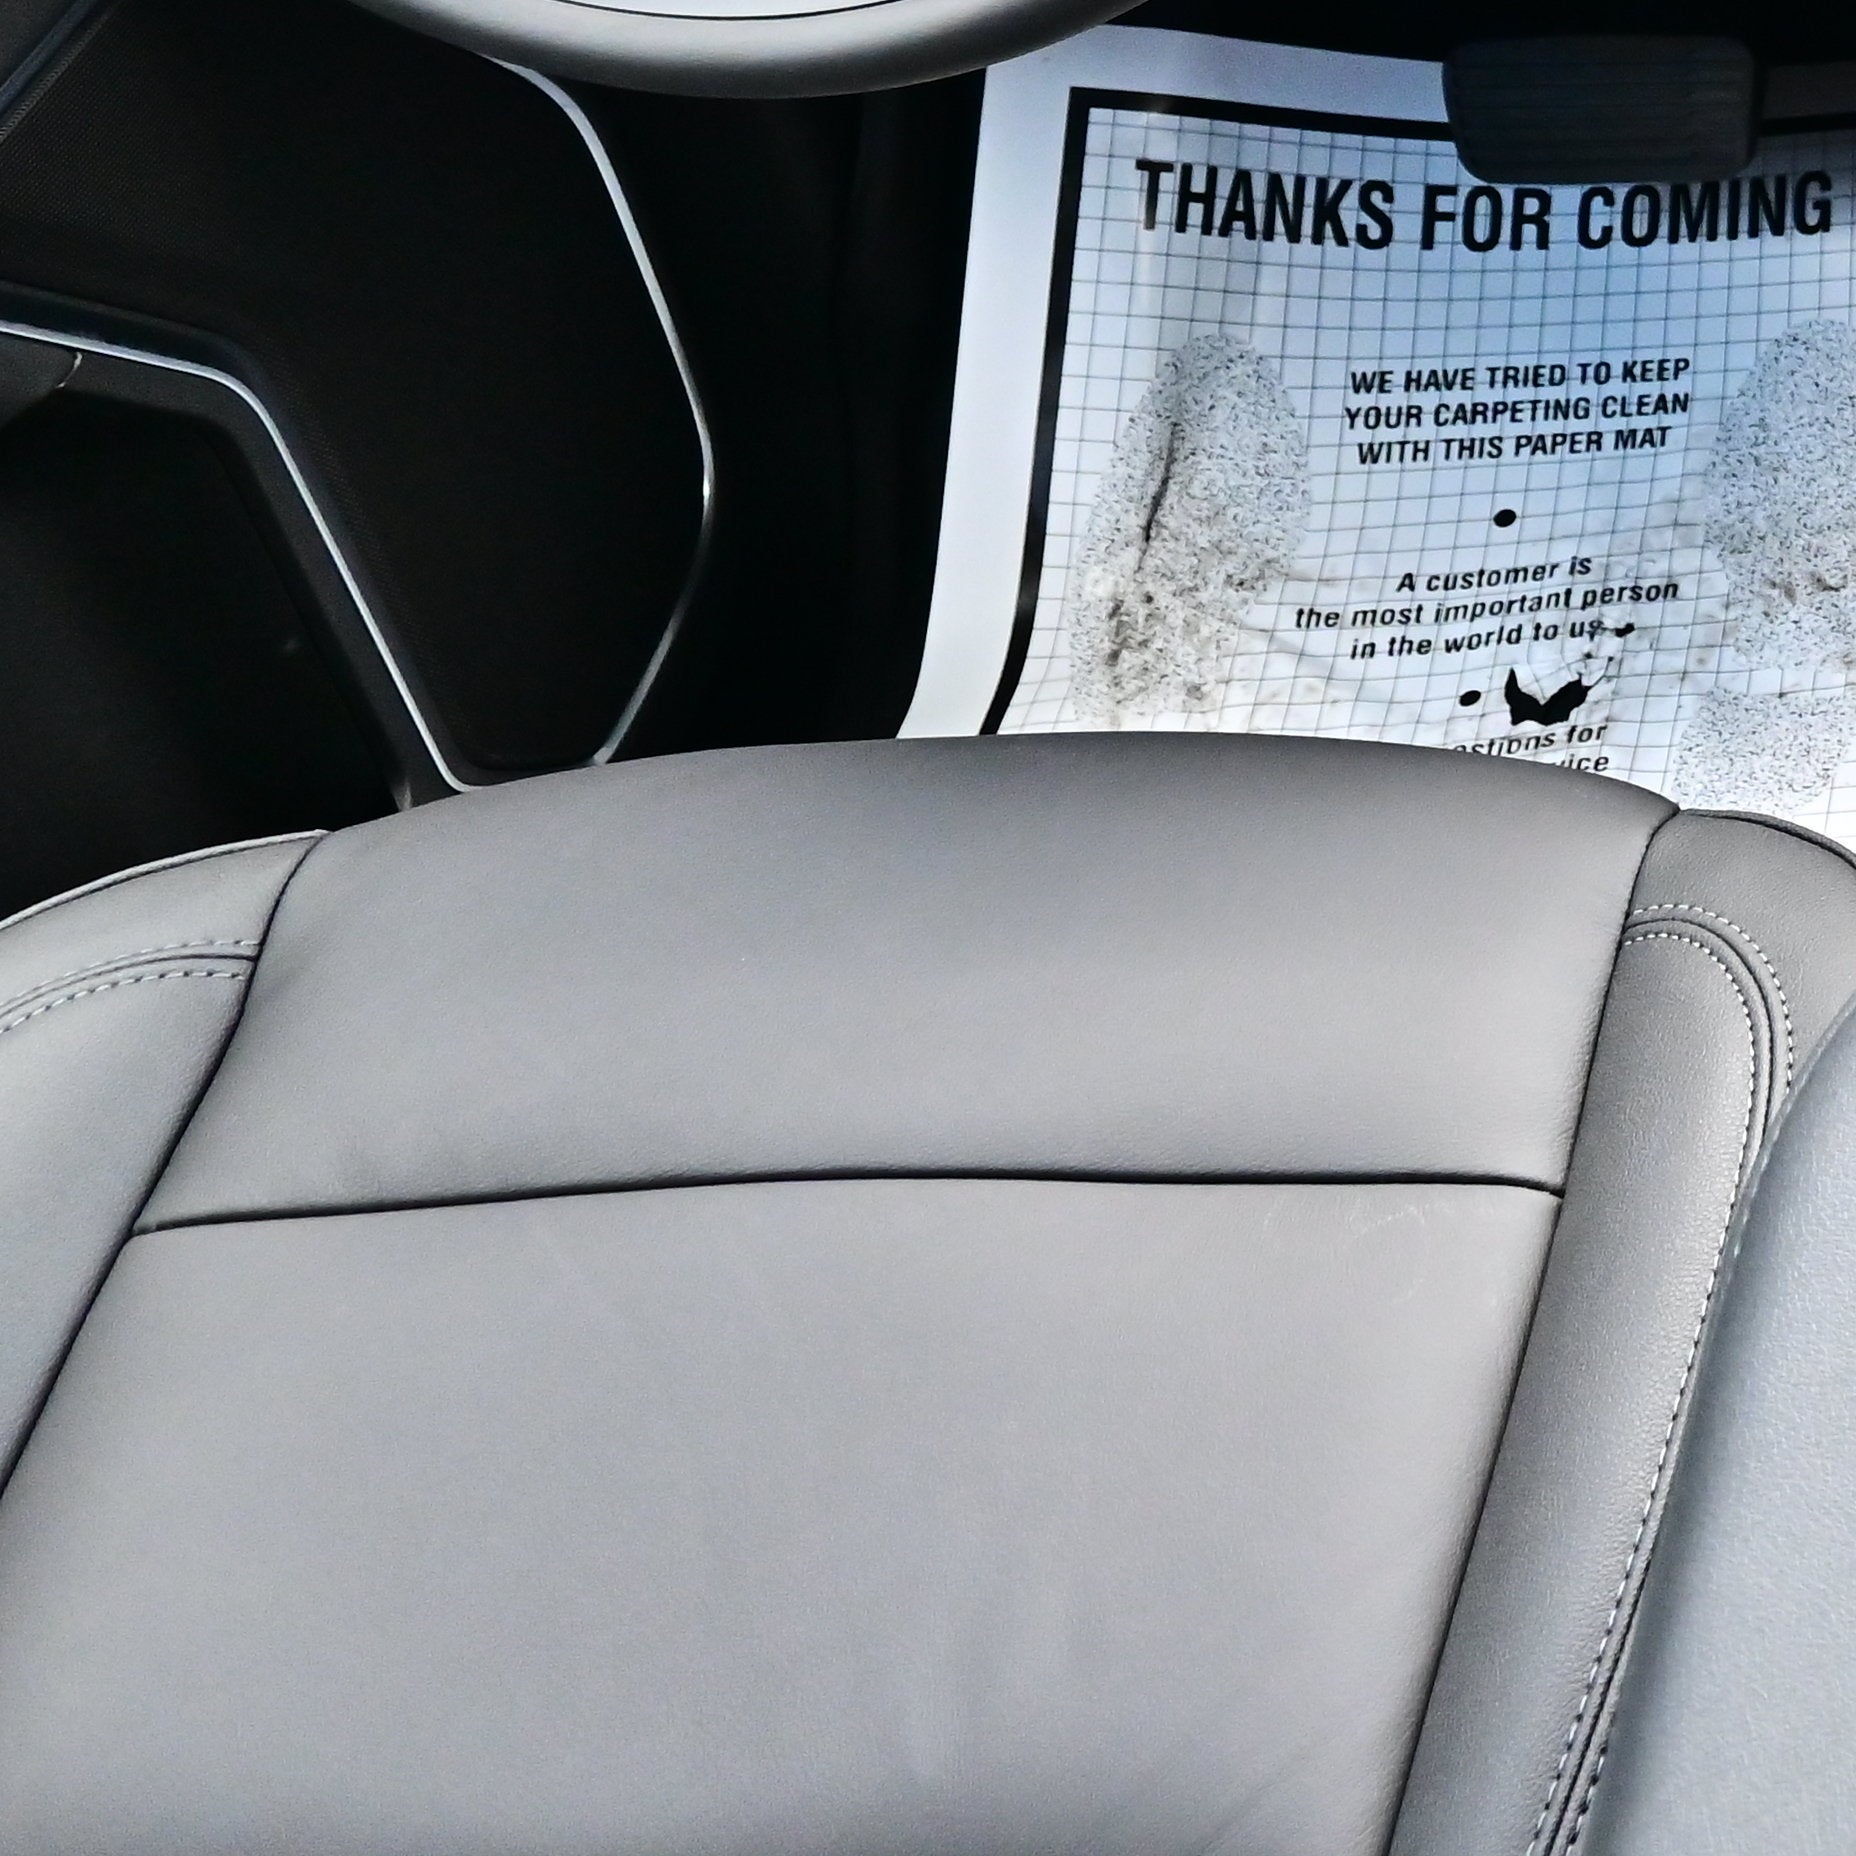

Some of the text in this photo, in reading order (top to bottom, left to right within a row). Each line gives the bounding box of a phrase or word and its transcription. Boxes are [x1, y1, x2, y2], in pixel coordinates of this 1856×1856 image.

[1135, 158, 1395, 250] THANKS
[1419, 183, 1552, 253] FOR
[1577, 169, 1833, 250] COMING
[1350, 357, 1691, 395] WE HAVE TRIED TO KEEP
[1345, 392, 1690, 431] YOUR CARPETING CLEAN
[1357, 425, 1672, 465] WITH THIS PAPER MAT
[1396, 555, 1593, 594] A customer is
[1295, 582, 1680, 630] the most important person
[1350, 638, 1377, 661] in
[1387, 632, 1433, 657] the
[1444, 624, 1523, 654] world
[1532, 621, 1559, 643] to
[1567, 724, 1609, 744] for
